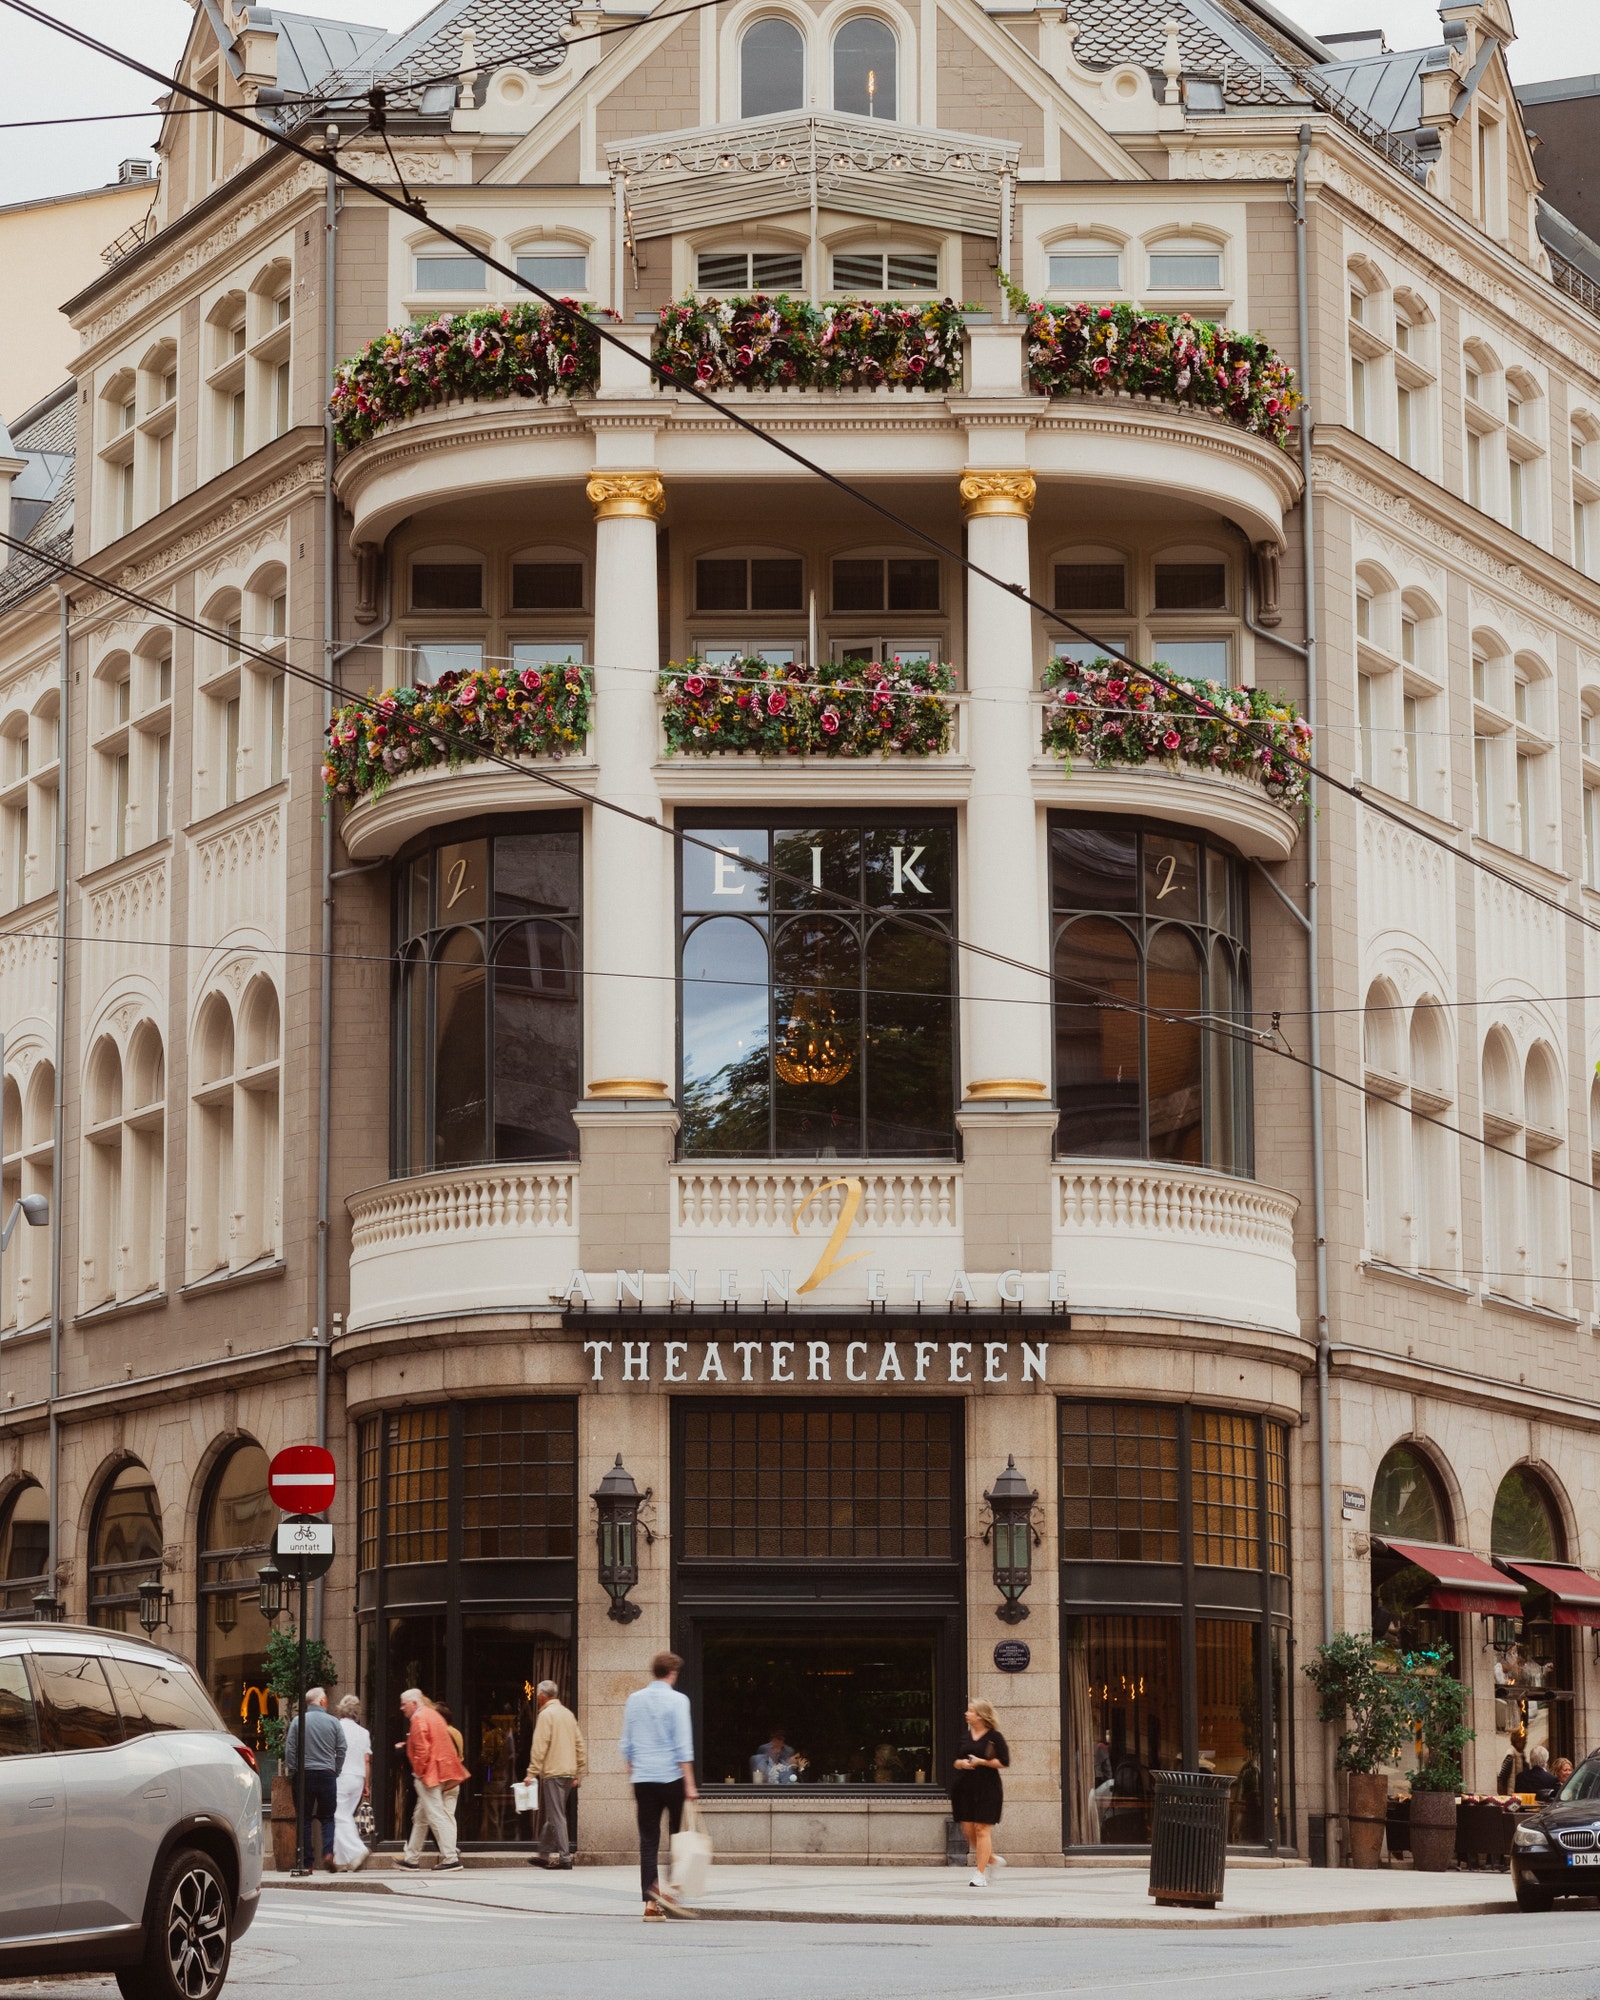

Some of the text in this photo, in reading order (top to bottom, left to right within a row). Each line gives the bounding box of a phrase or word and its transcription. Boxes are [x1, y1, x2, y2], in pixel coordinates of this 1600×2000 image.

[711, 846, 933, 895] EIK
[564, 1177, 1070, 1301] ANNEN 2 ETAGE
[583, 1341, 1048, 1382] THEATERCAFEEN
[289, 1543, 320, 1551] unntatt
[1575, 1855, 1588, 1864] DN
